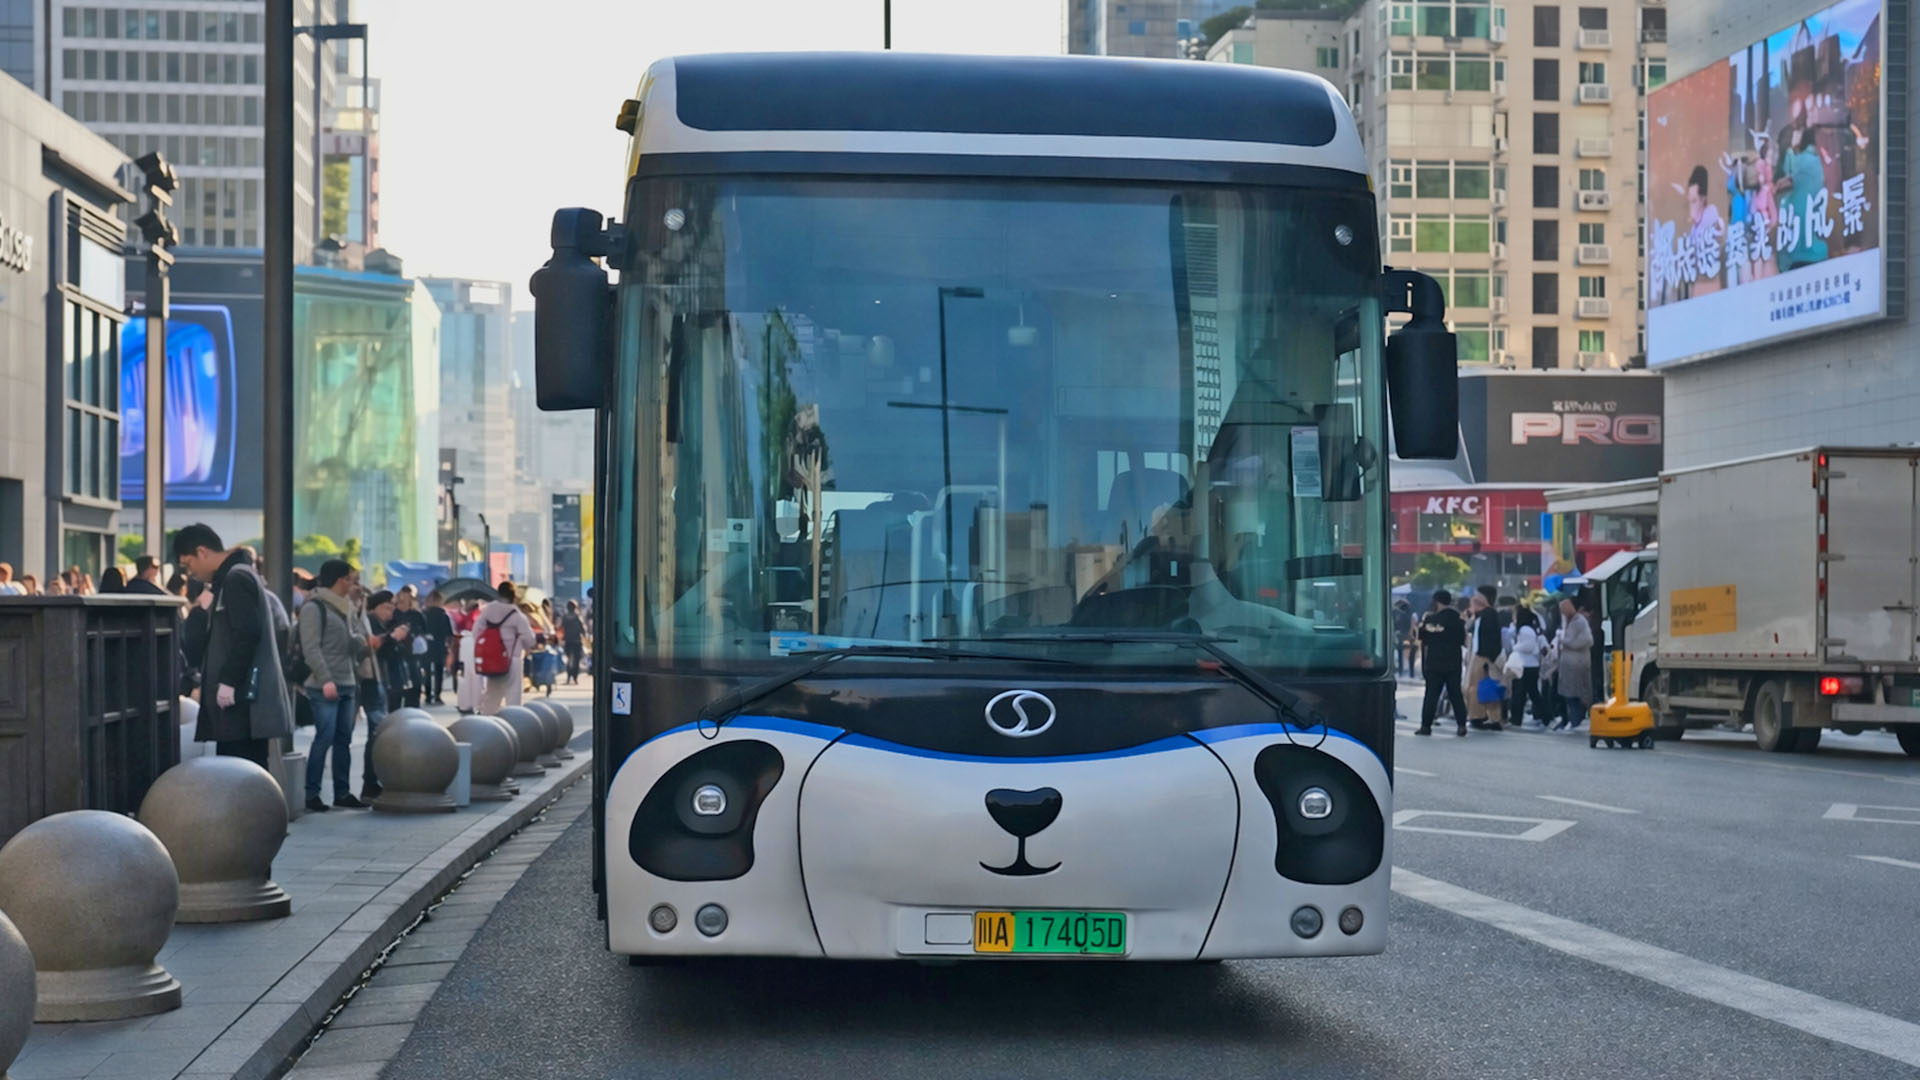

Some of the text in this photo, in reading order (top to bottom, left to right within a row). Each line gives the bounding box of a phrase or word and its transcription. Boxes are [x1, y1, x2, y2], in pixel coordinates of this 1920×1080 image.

[1511, 412, 1661, 445] PRO
[1423, 497, 1479, 514] KFC
[1026, 916, 1123, 948] 17405D
